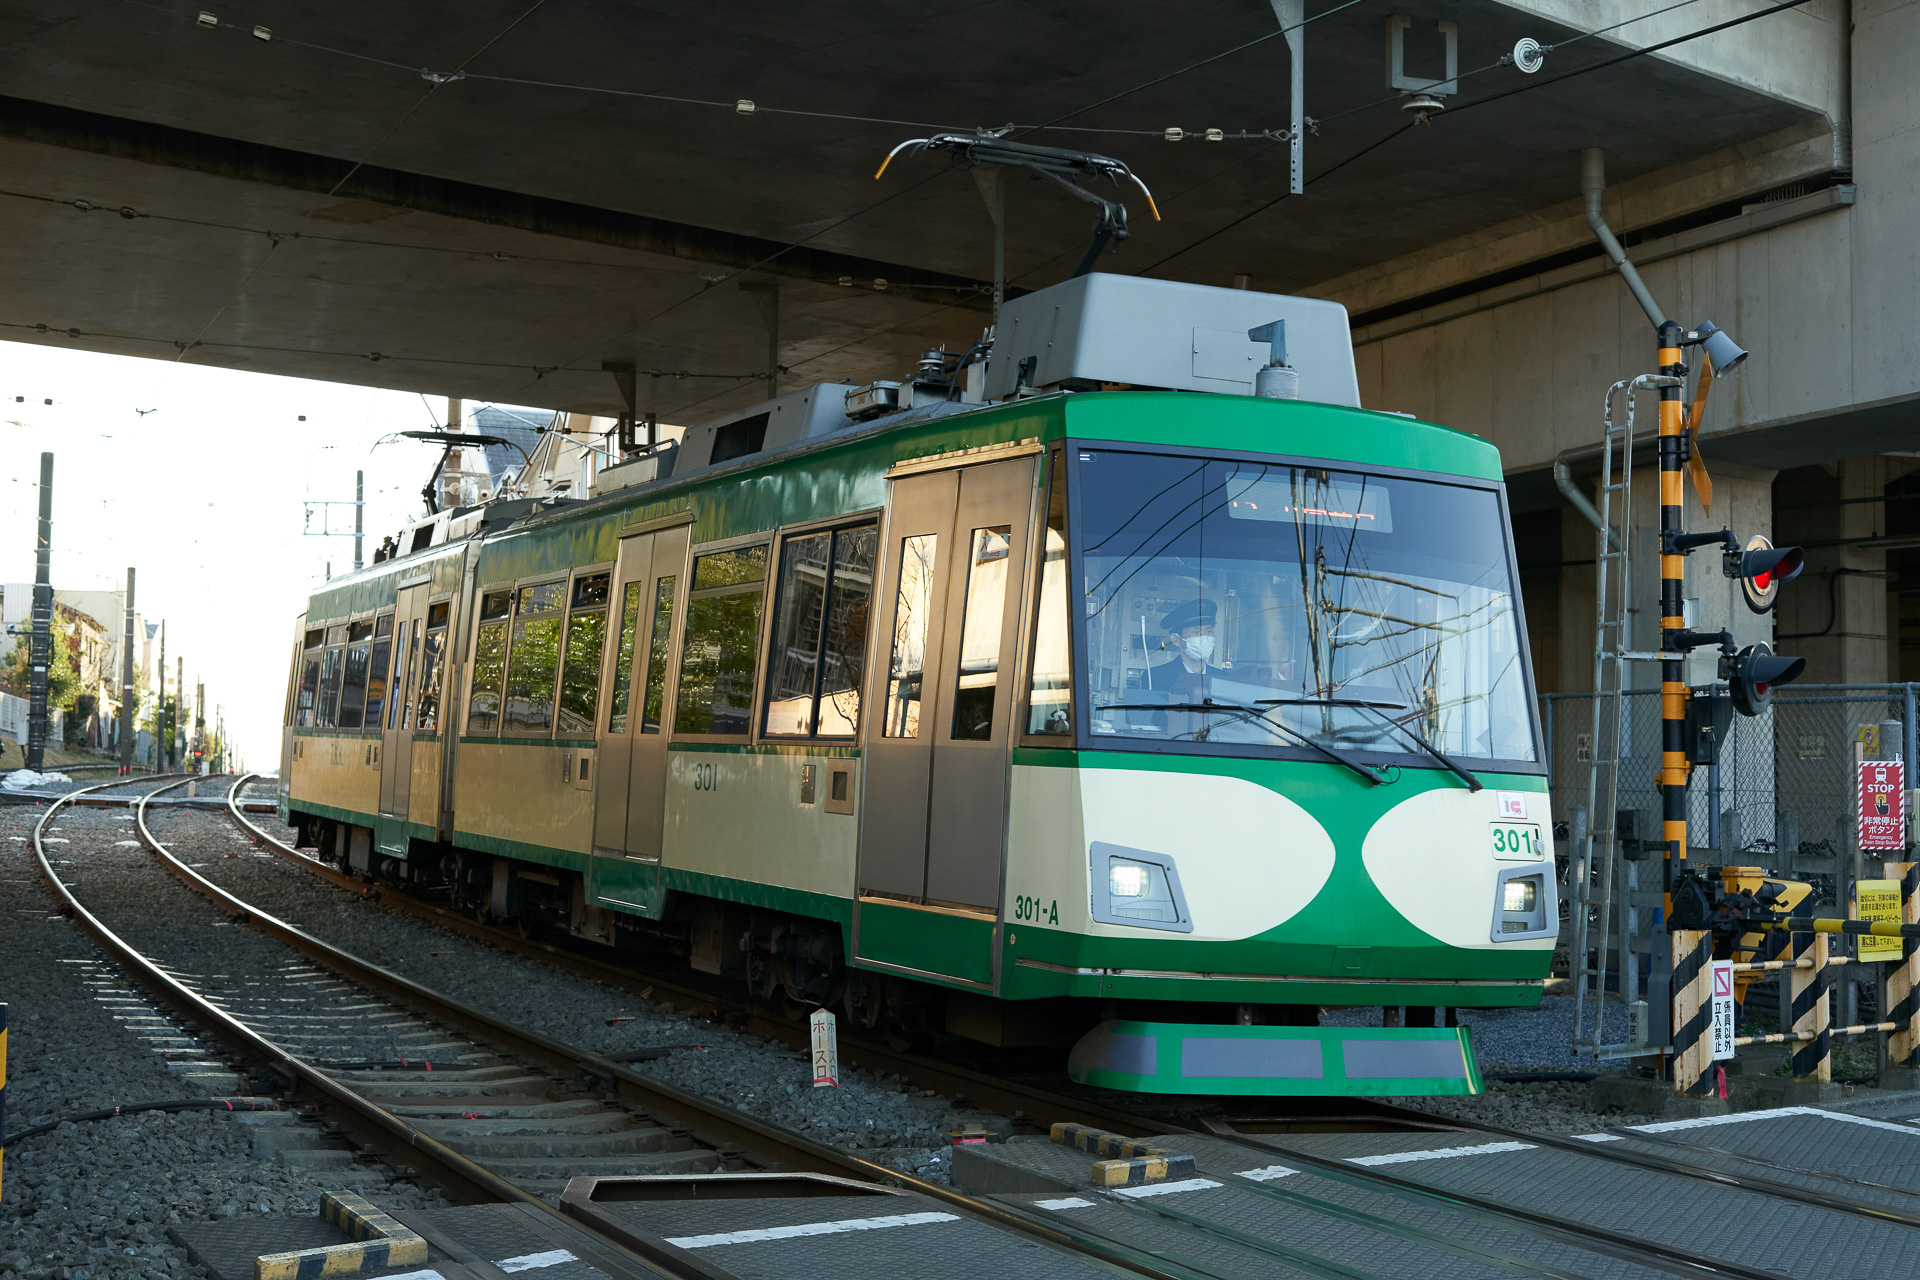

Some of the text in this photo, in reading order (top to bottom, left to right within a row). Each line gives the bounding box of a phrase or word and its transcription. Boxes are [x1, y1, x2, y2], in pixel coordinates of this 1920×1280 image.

[694, 763, 718, 792] 301
[1867, 784, 1895, 793] STOP
[1864, 816, 1899, 826] 非常停止
[1868, 826, 1895, 834] ボタン
[1493, 828, 1531, 854] 301
[1015, 894, 1059, 926] 301-A
[1723, 1001, 1731, 1052] 係員以外
